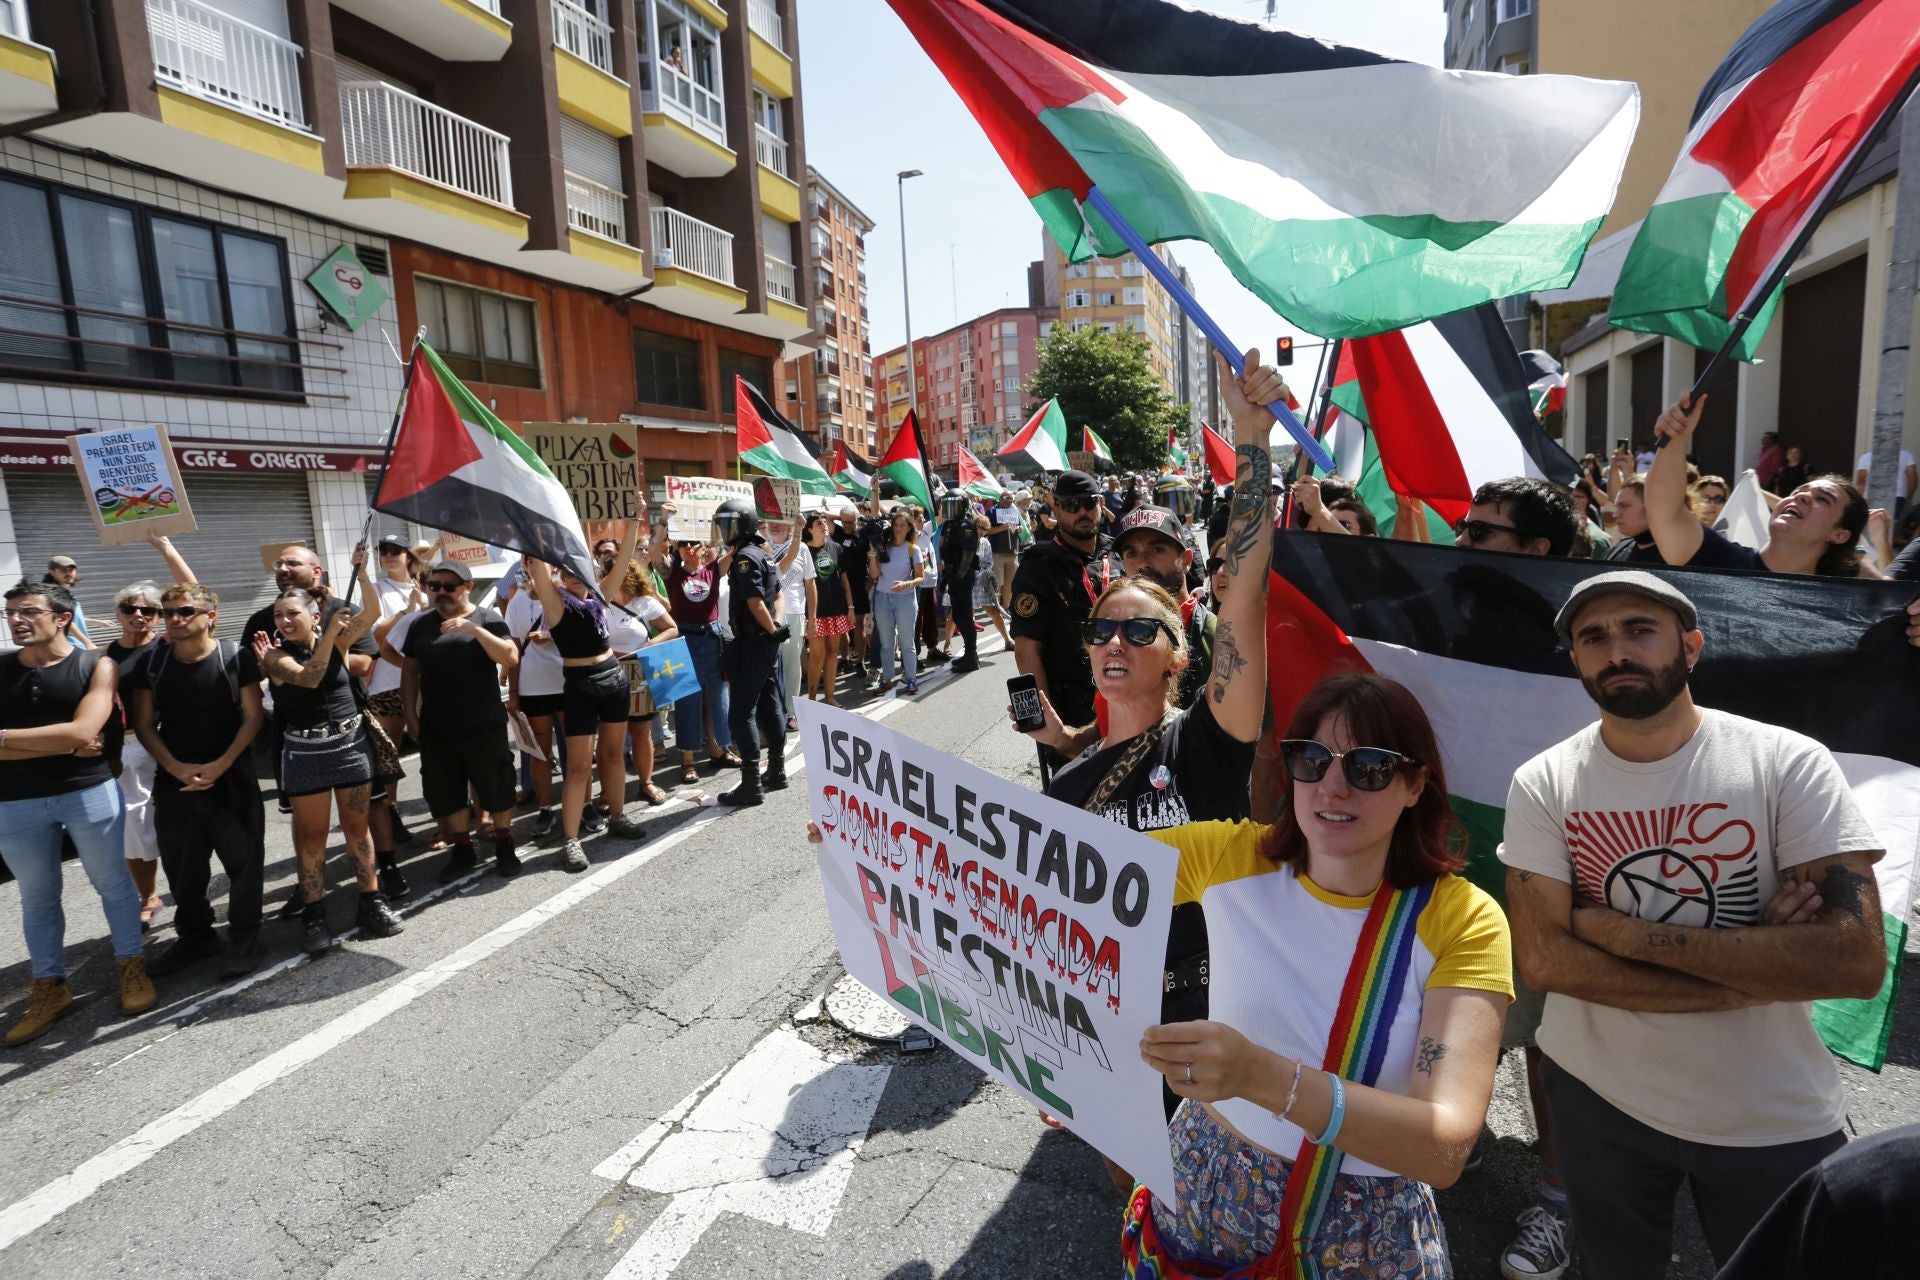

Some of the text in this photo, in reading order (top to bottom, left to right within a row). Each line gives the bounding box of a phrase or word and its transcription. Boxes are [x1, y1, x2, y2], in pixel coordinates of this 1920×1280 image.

[101, 433, 136, 446] ISRAEL
[534, 434, 608, 462] PUXA
[0, 454, 47, 464] desde
[86, 440, 157, 459] PREMIER TECH
[102, 453, 148, 467] NUN SUIS
[249, 452, 336, 470] ORIENTE
[551, 461, 637, 489] LESTINA
[447, 546, 487, 560] MUERTES
[1013, 690, 1035, 704] STOP
[955, 784, 1149, 928] ESTADO
[822, 785, 956, 906] SIONISTA
[961, 860, 1121, 1014] GENOCIDA
[856, 862, 1113, 1072] PALESTINA
[873, 927, 1075, 1120] LIBRE
